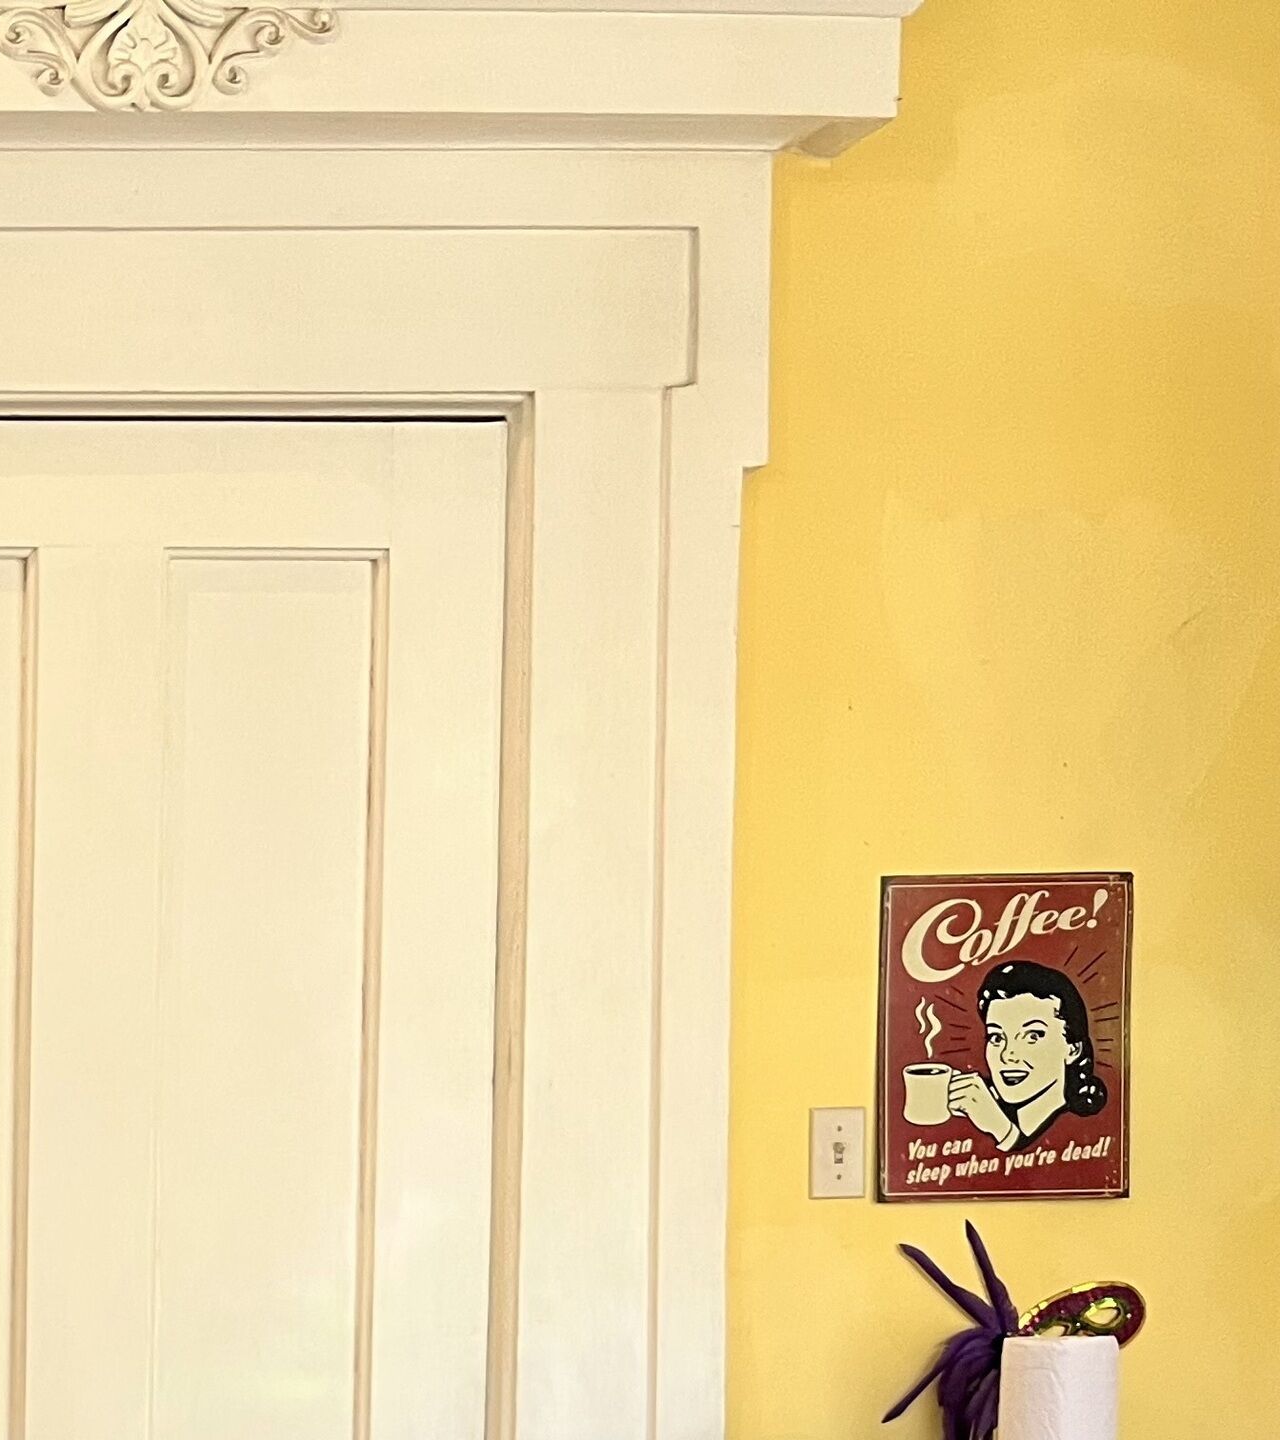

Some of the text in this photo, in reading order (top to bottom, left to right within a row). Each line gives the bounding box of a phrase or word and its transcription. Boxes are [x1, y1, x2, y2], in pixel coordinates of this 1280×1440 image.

[901, 888, 1109, 983] Coffee!
[905, 1136, 1112, 1186] sleep when you're dead!
[907, 1138, 972, 1160] You can
